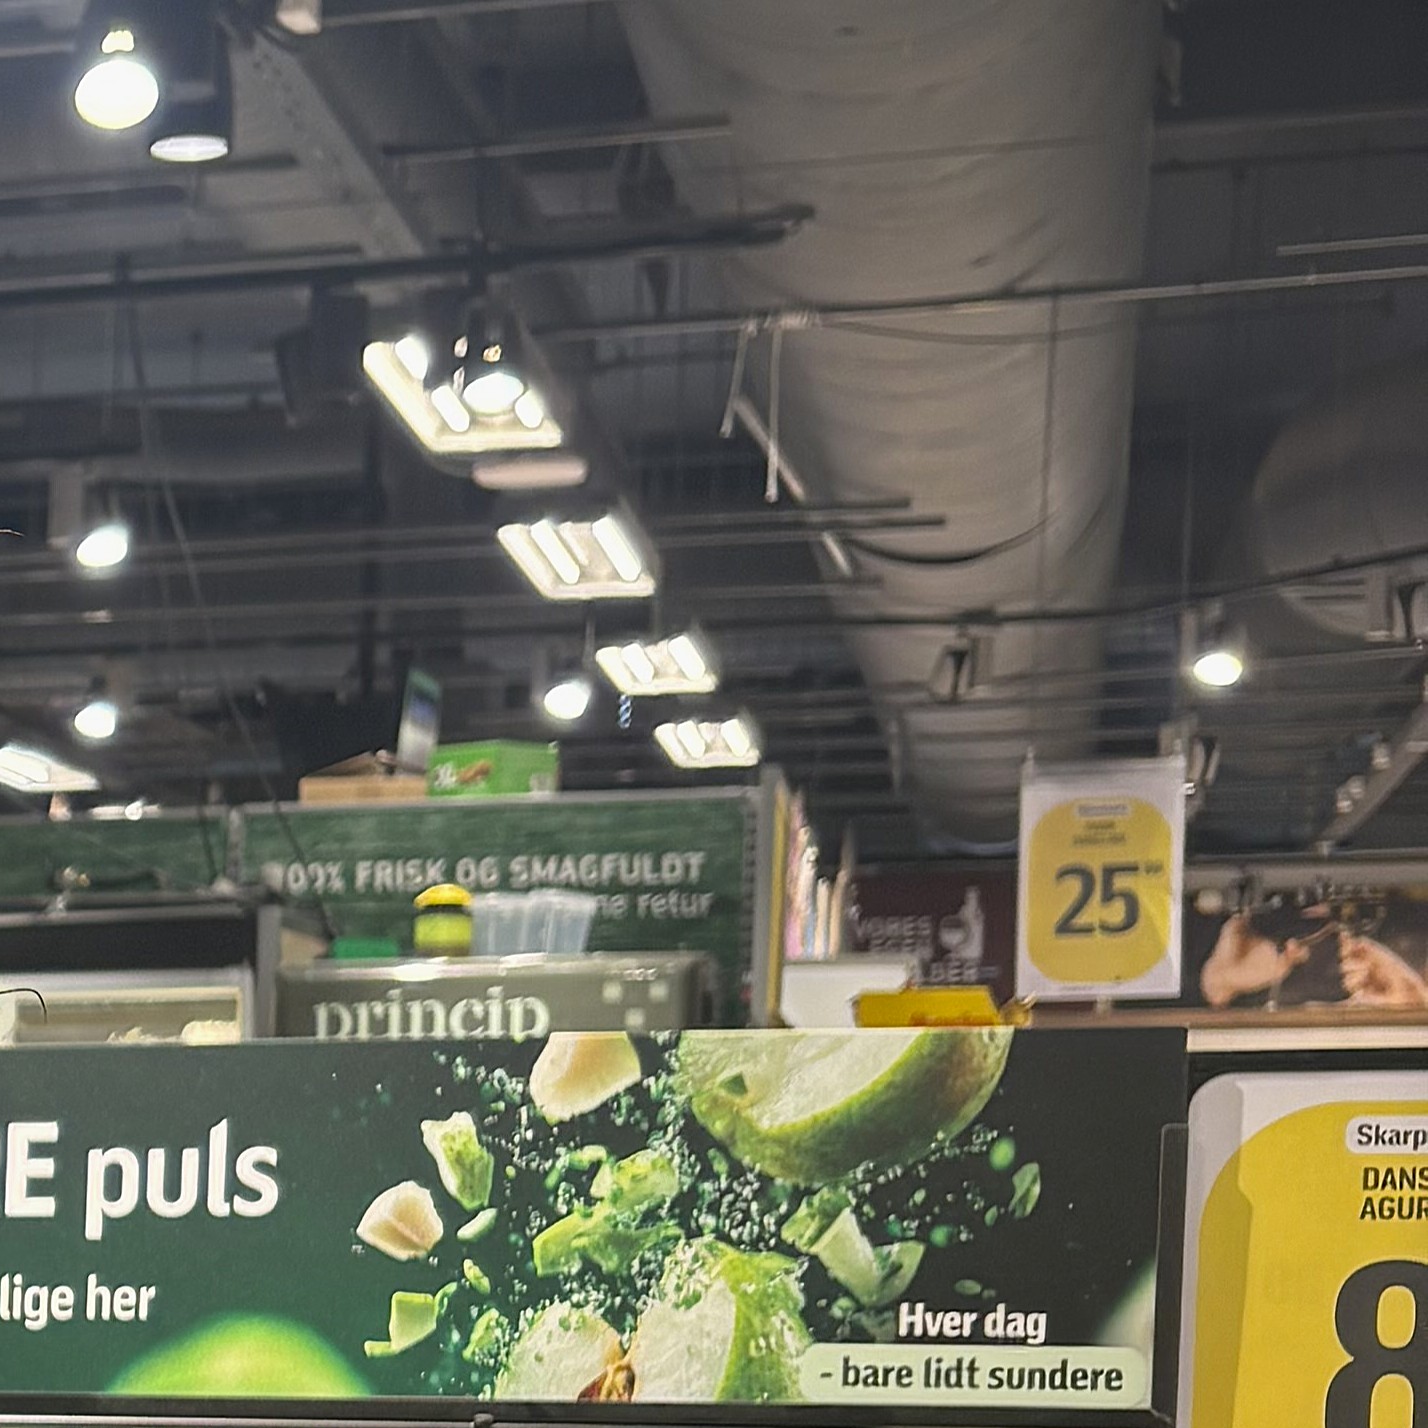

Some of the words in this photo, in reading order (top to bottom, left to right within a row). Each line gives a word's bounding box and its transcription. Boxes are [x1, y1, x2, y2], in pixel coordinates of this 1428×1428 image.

[354, 859, 444, 892] FRISK
[456, 858, 500, 888] OG
[510, 851, 709, 887] SMAGFULDT
[1054, 861, 1140, 939] 25
[313, 986, 550, 1039] princip
[85, 1117, 281, 1241] puls
[1362, 1166, 1428, 1191] DANS
[1359, 1196, 1428, 1221] AGUR
[85, 1272, 157, 1322] her
[898, 1302, 976, 1338] Hver
[983, 1303, 1048, 1345] dag
[842, 1355, 914, 1389] bare
[923, 1356, 981, 1390] lidt
[988, 1358, 1124, 1393] sundere
